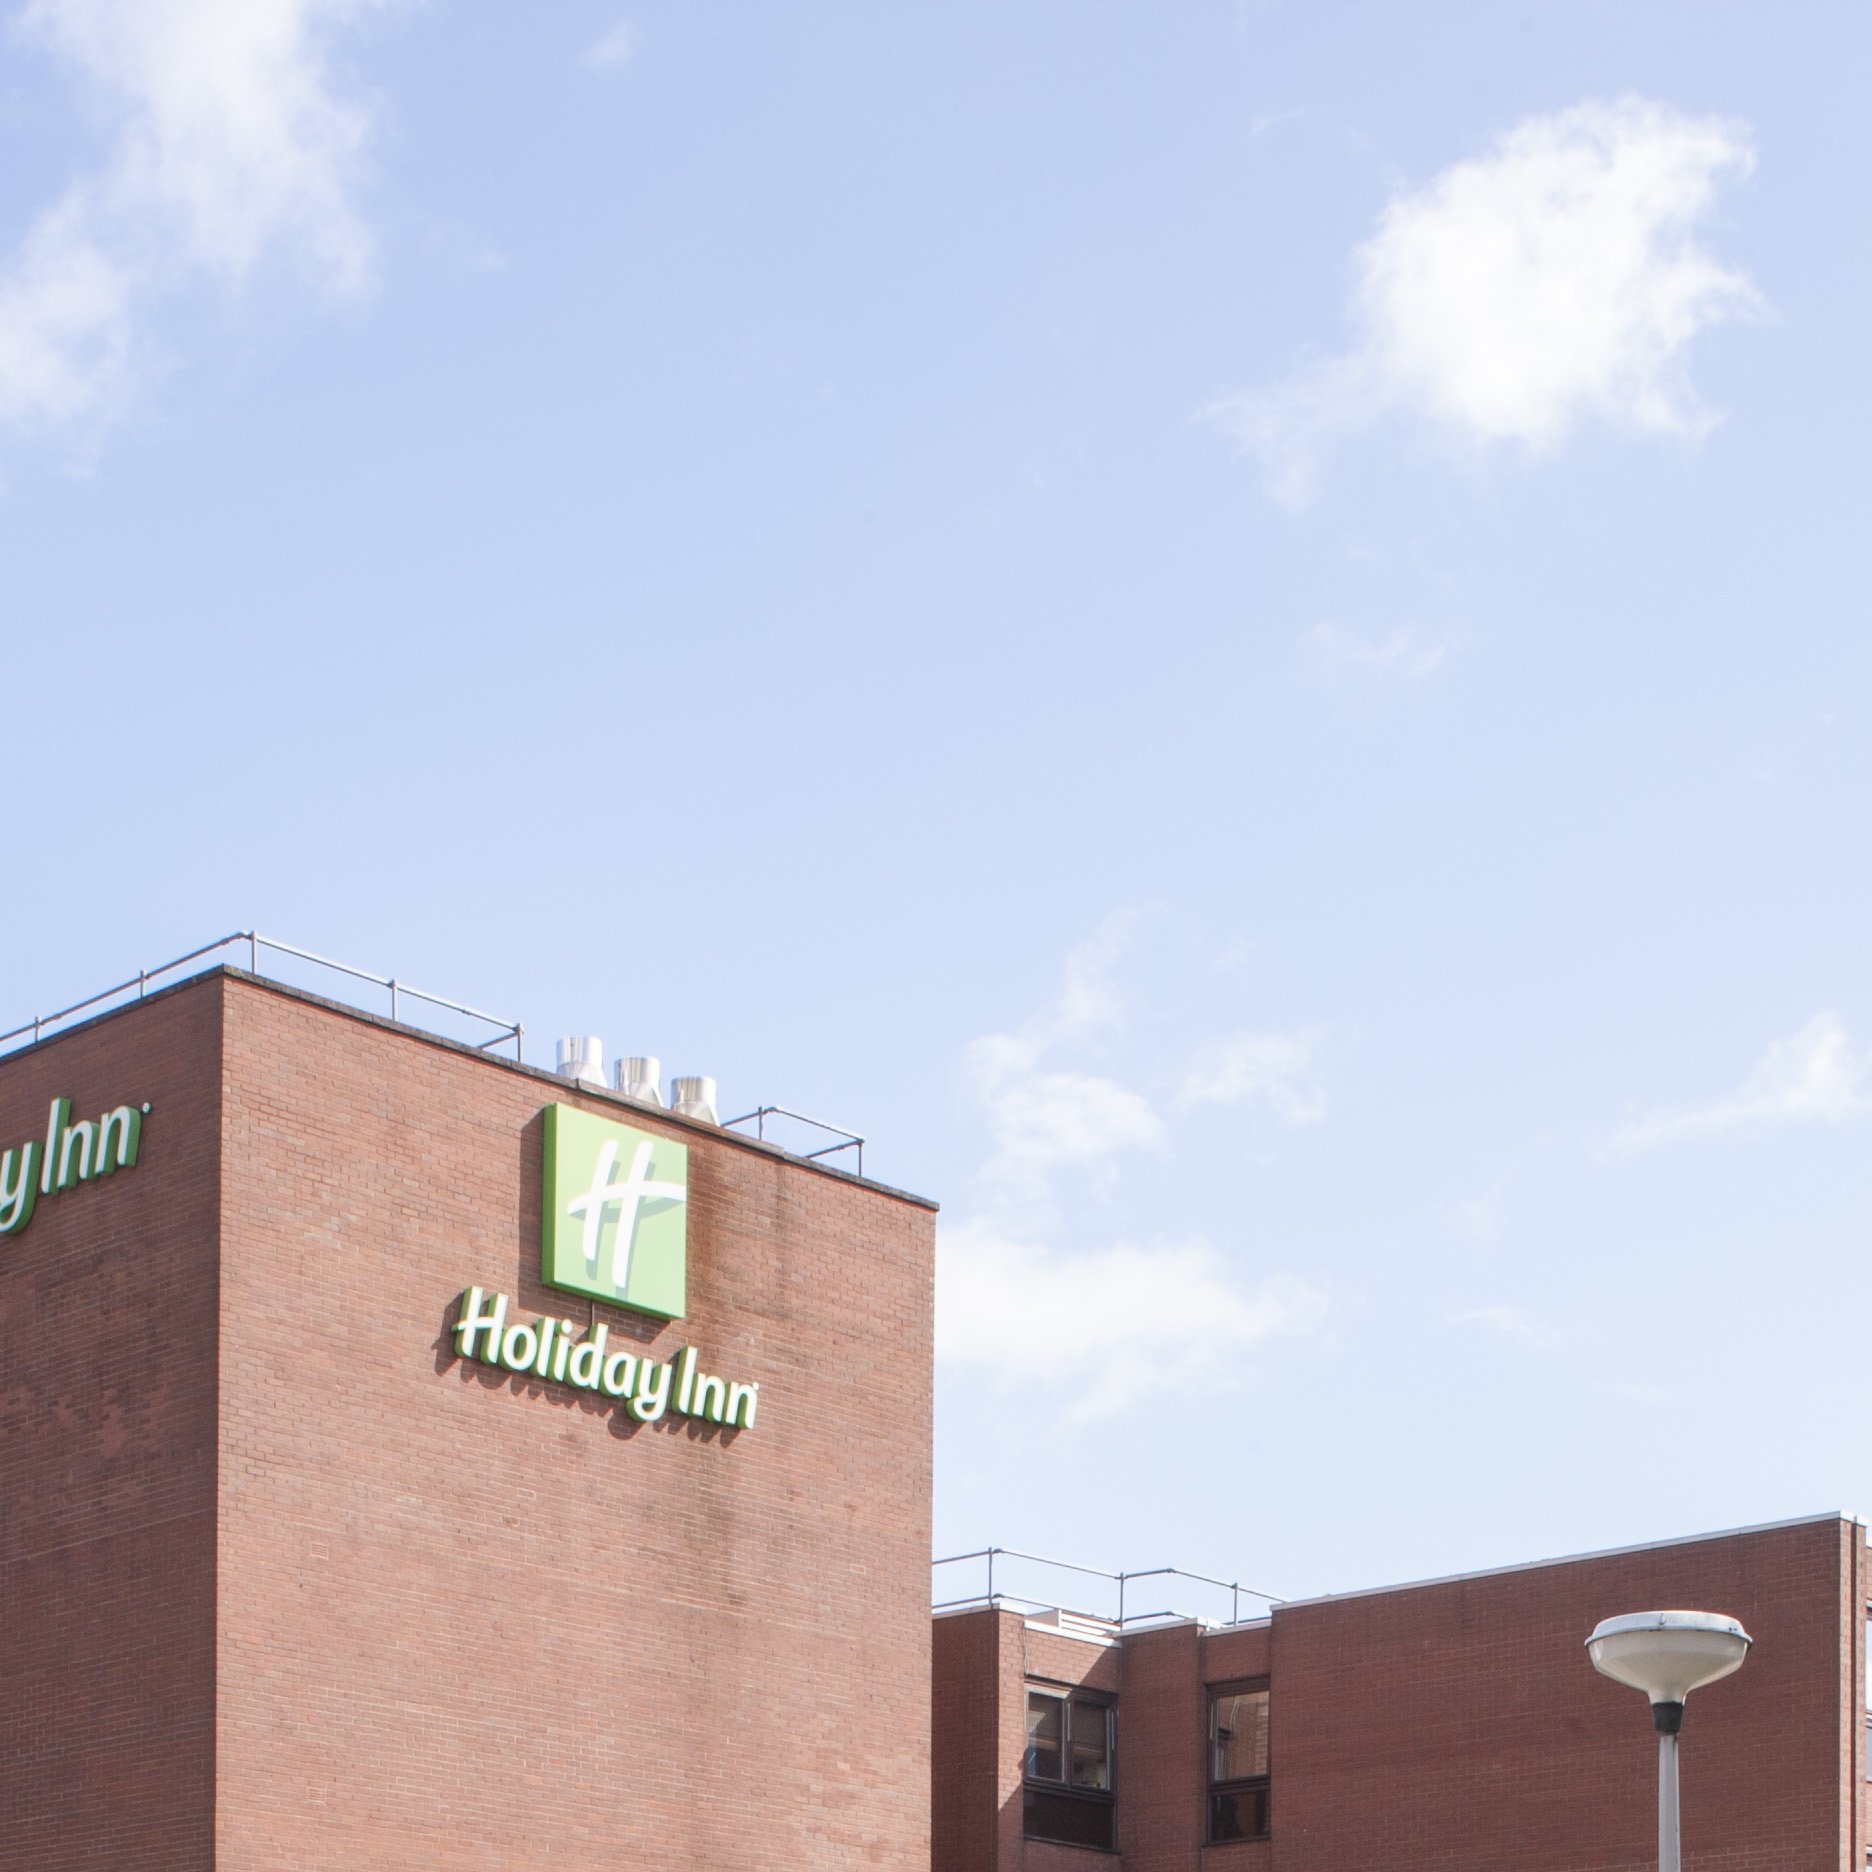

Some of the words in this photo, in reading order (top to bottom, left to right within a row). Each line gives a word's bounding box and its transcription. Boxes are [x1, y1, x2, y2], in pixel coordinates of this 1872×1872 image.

[40, 1097, 142, 1195] Inn
[451, 1285, 673, 1422] Holiday
[672, 1345, 758, 1430] Inn
